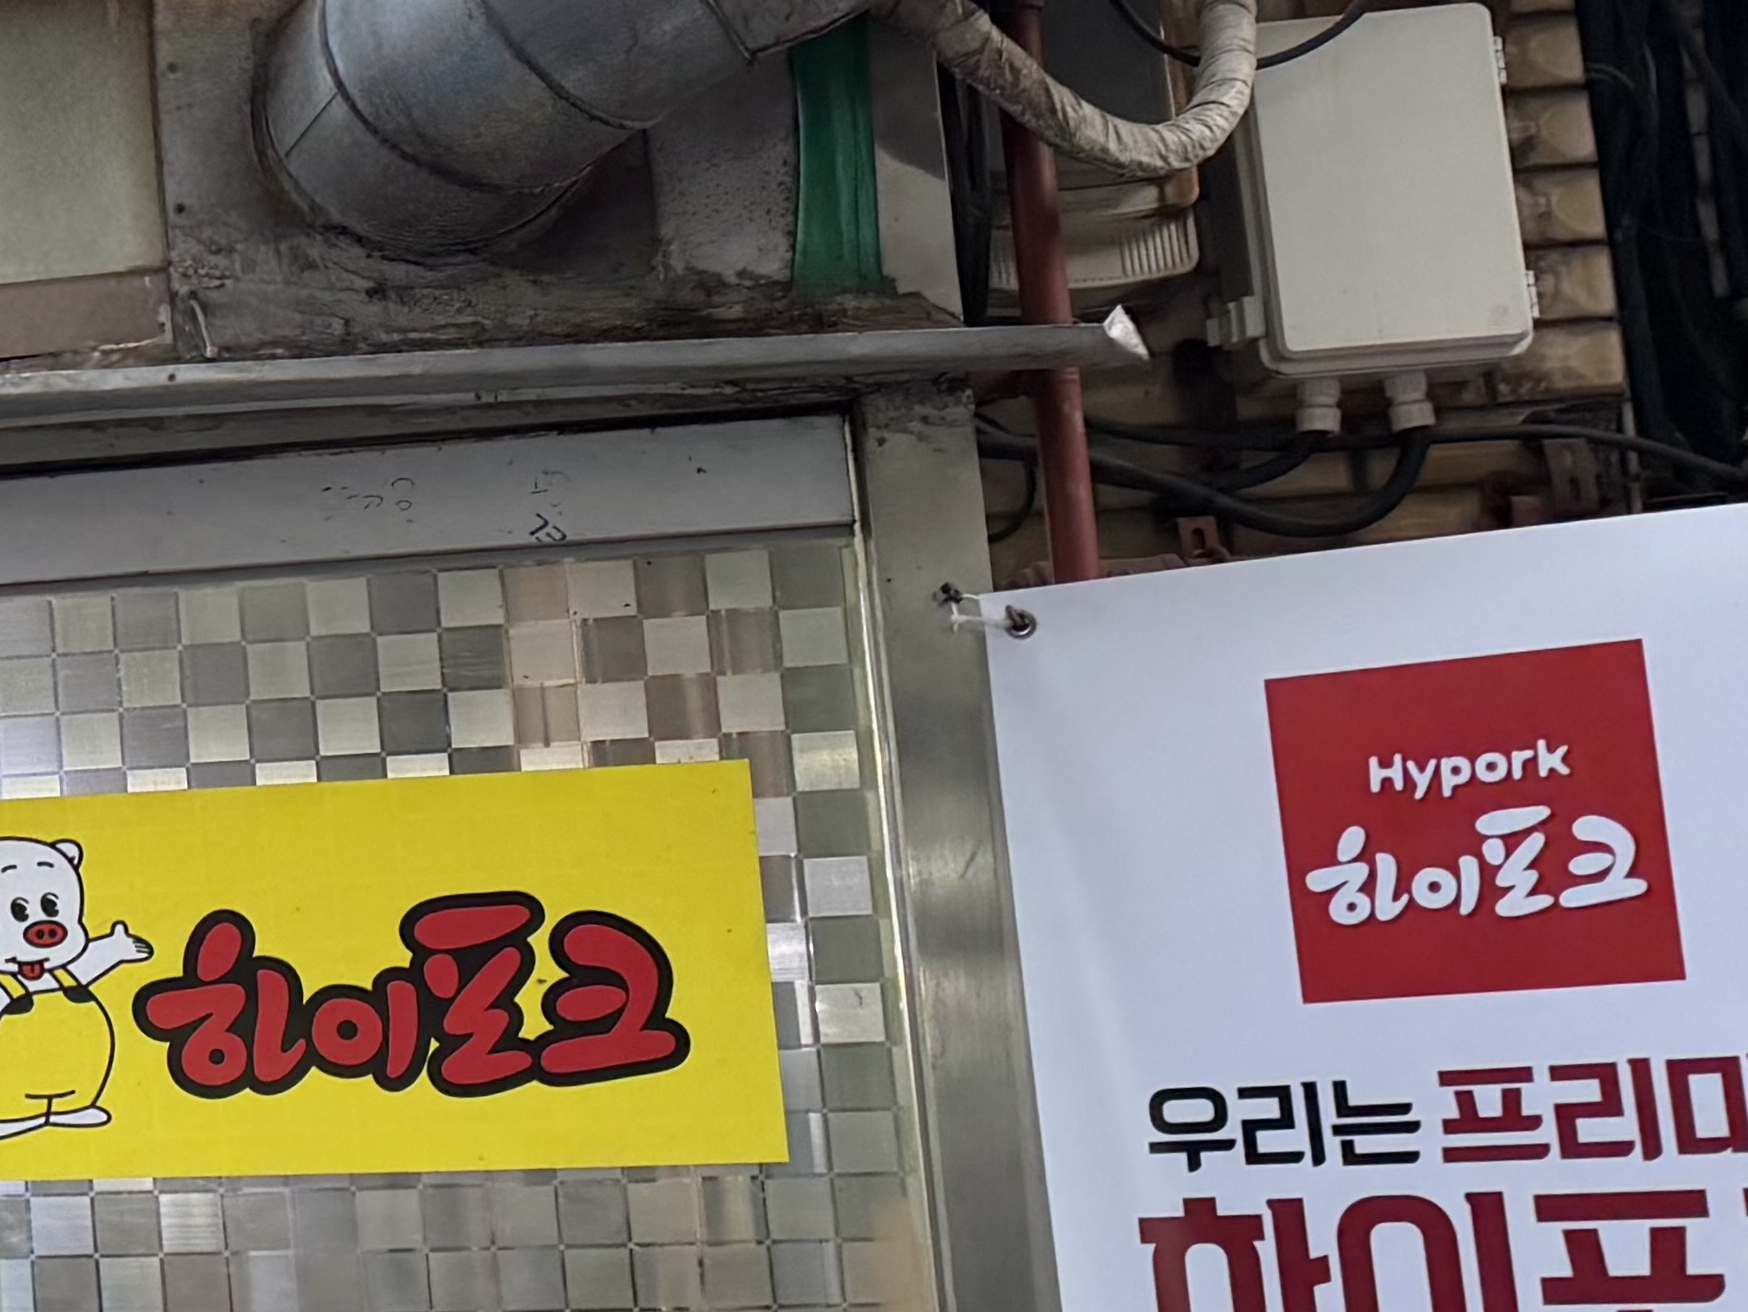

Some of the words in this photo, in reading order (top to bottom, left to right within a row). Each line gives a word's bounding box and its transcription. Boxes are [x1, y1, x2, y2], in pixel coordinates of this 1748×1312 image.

[1369, 739, 1571, 798] Hypork
[1305, 805, 1648, 926] 하이포크
[133, 890, 690, 1098] 하이포크
[1148, 1080, 1421, 1173] 우리는
